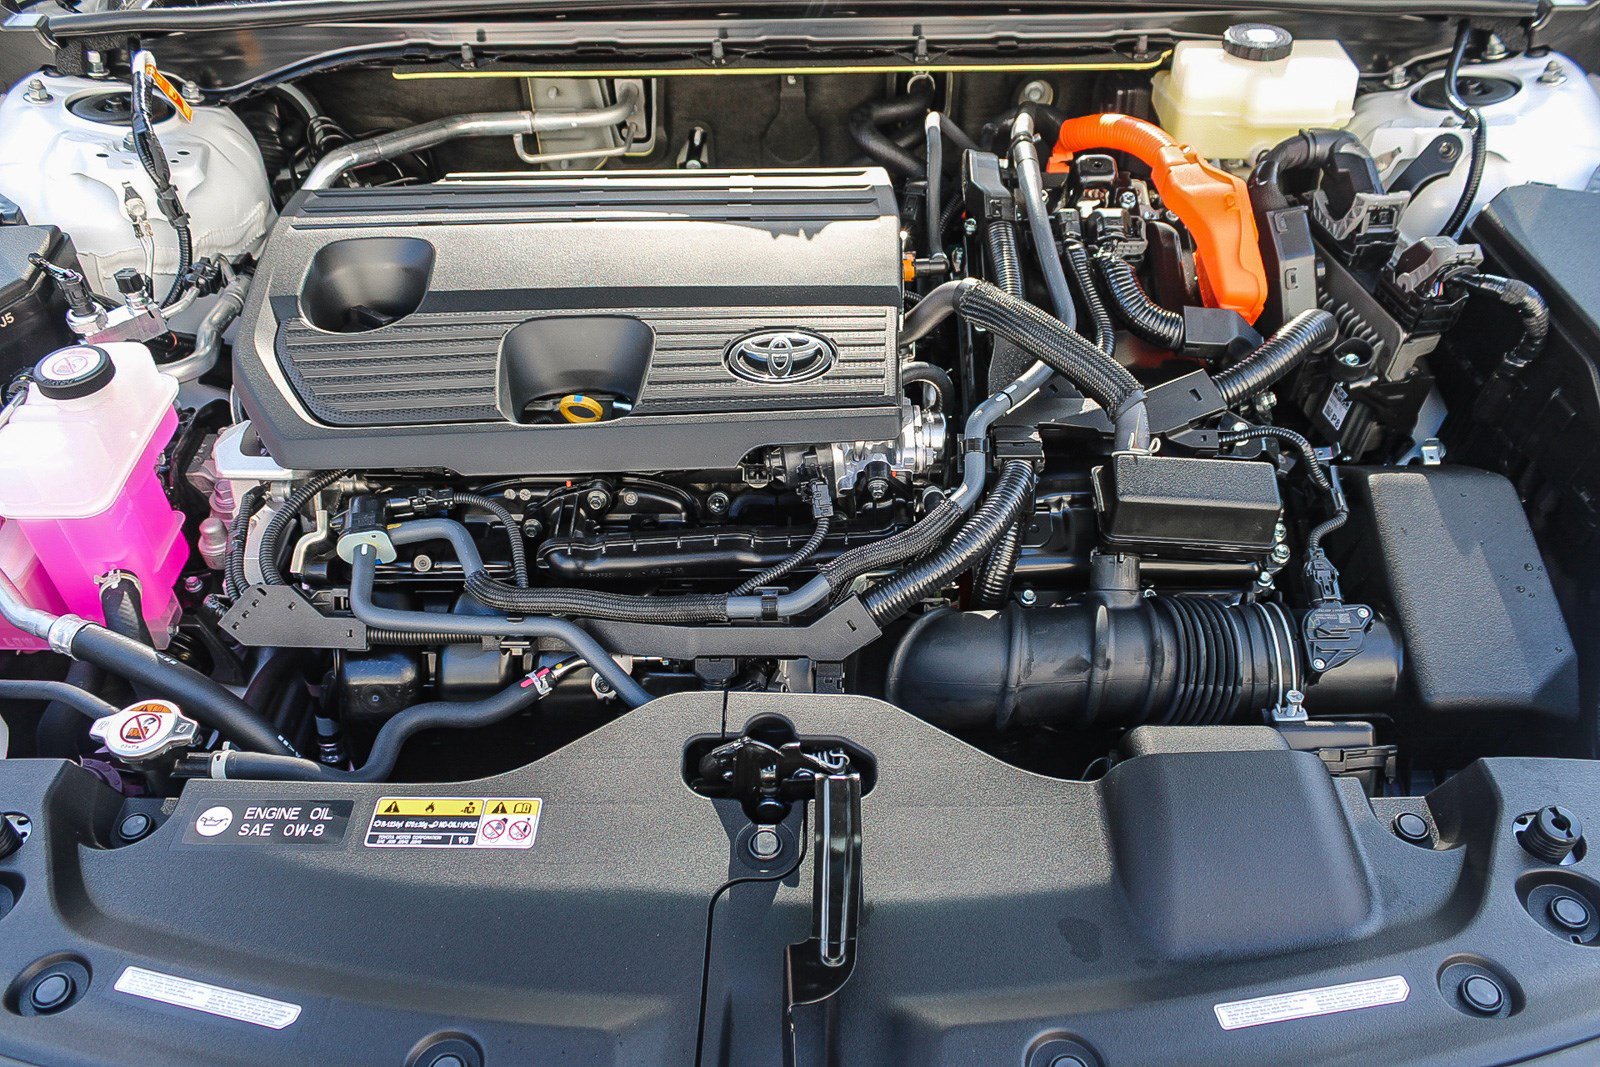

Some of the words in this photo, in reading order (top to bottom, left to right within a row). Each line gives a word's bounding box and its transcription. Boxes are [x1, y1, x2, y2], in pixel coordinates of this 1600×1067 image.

[243, 807, 302, 820] ENGINE
[309, 807, 333, 820] OIL
[238, 823, 274, 837] SAE
[283, 823, 325, 837] 0W-8
